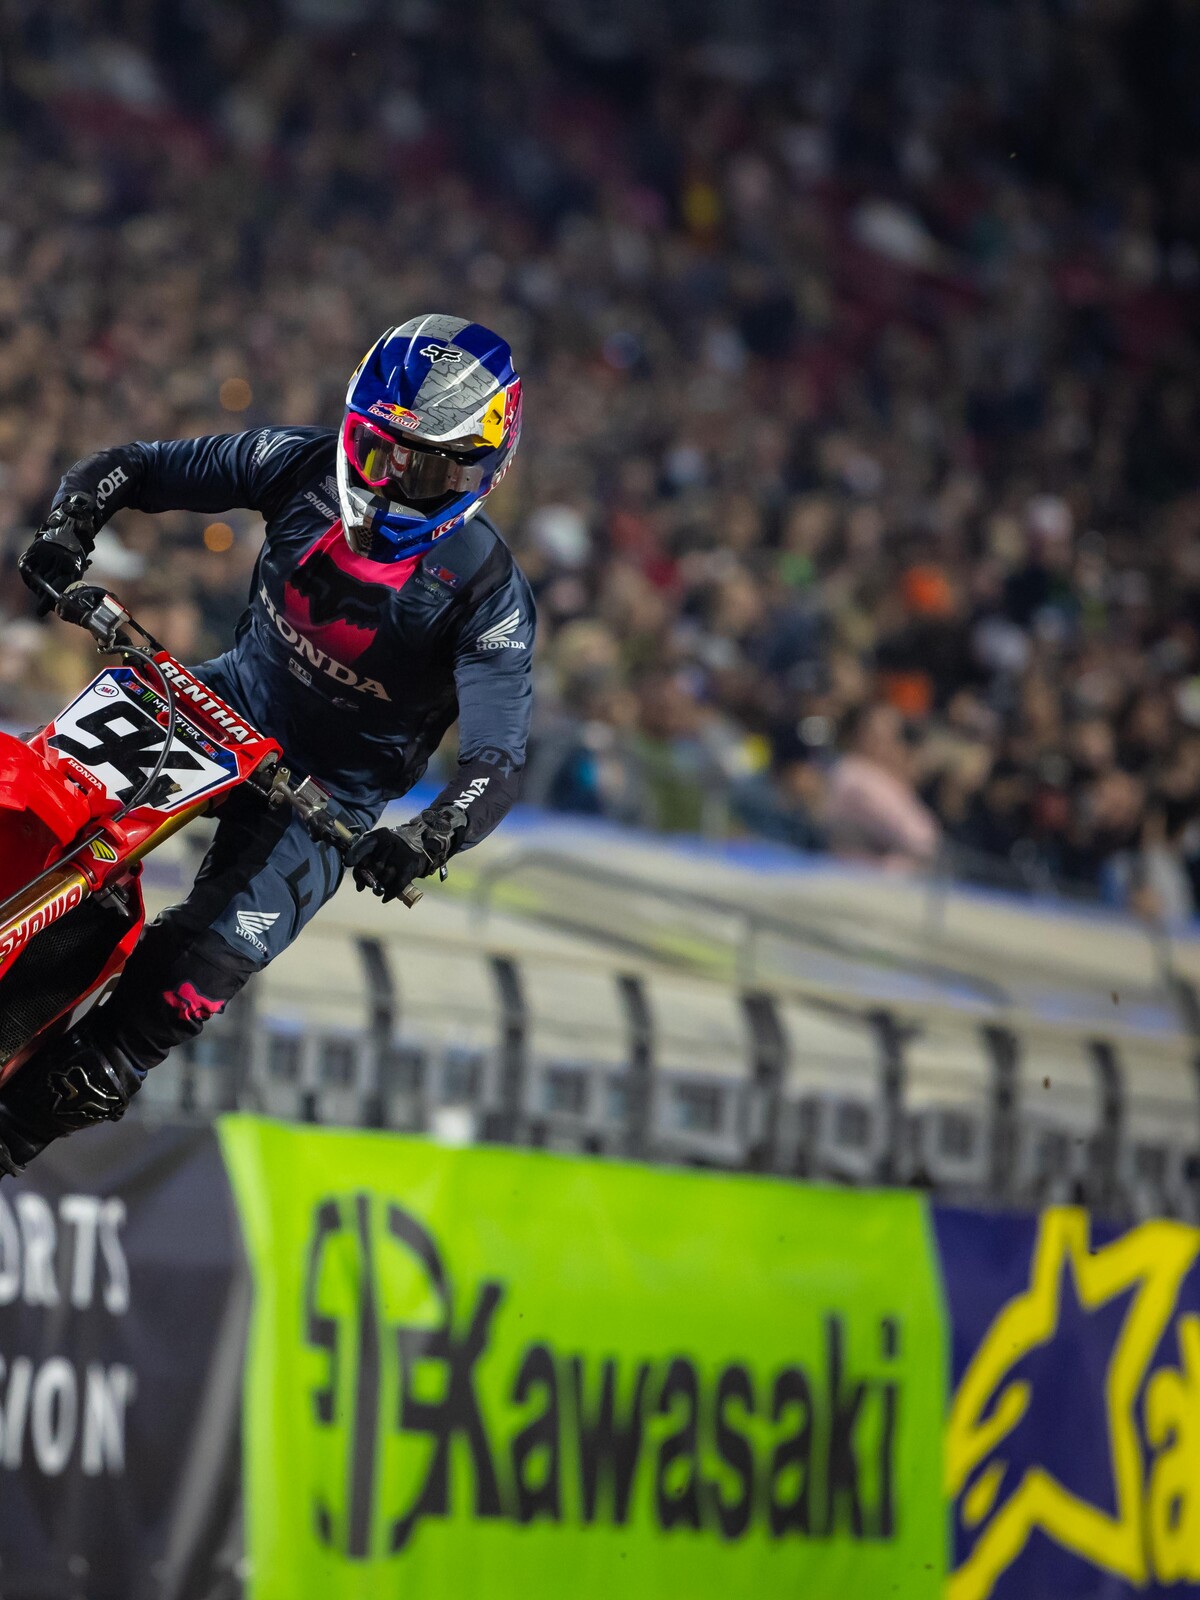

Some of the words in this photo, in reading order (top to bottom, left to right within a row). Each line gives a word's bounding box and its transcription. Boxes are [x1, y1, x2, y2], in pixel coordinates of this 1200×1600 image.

[368, 405, 392, 421] Red
[391, 414, 419, 430] Bull
[259, 582, 392, 702] HONDA
[475, 640, 527, 651] HONDA
[153, 698, 201, 740] MOSTER
[47, 701, 205, 808] 94
[479, 750, 514, 779] OX
[67, 759, 102, 791] HONDA
[398, 1276, 900, 1544] Kawasaki
